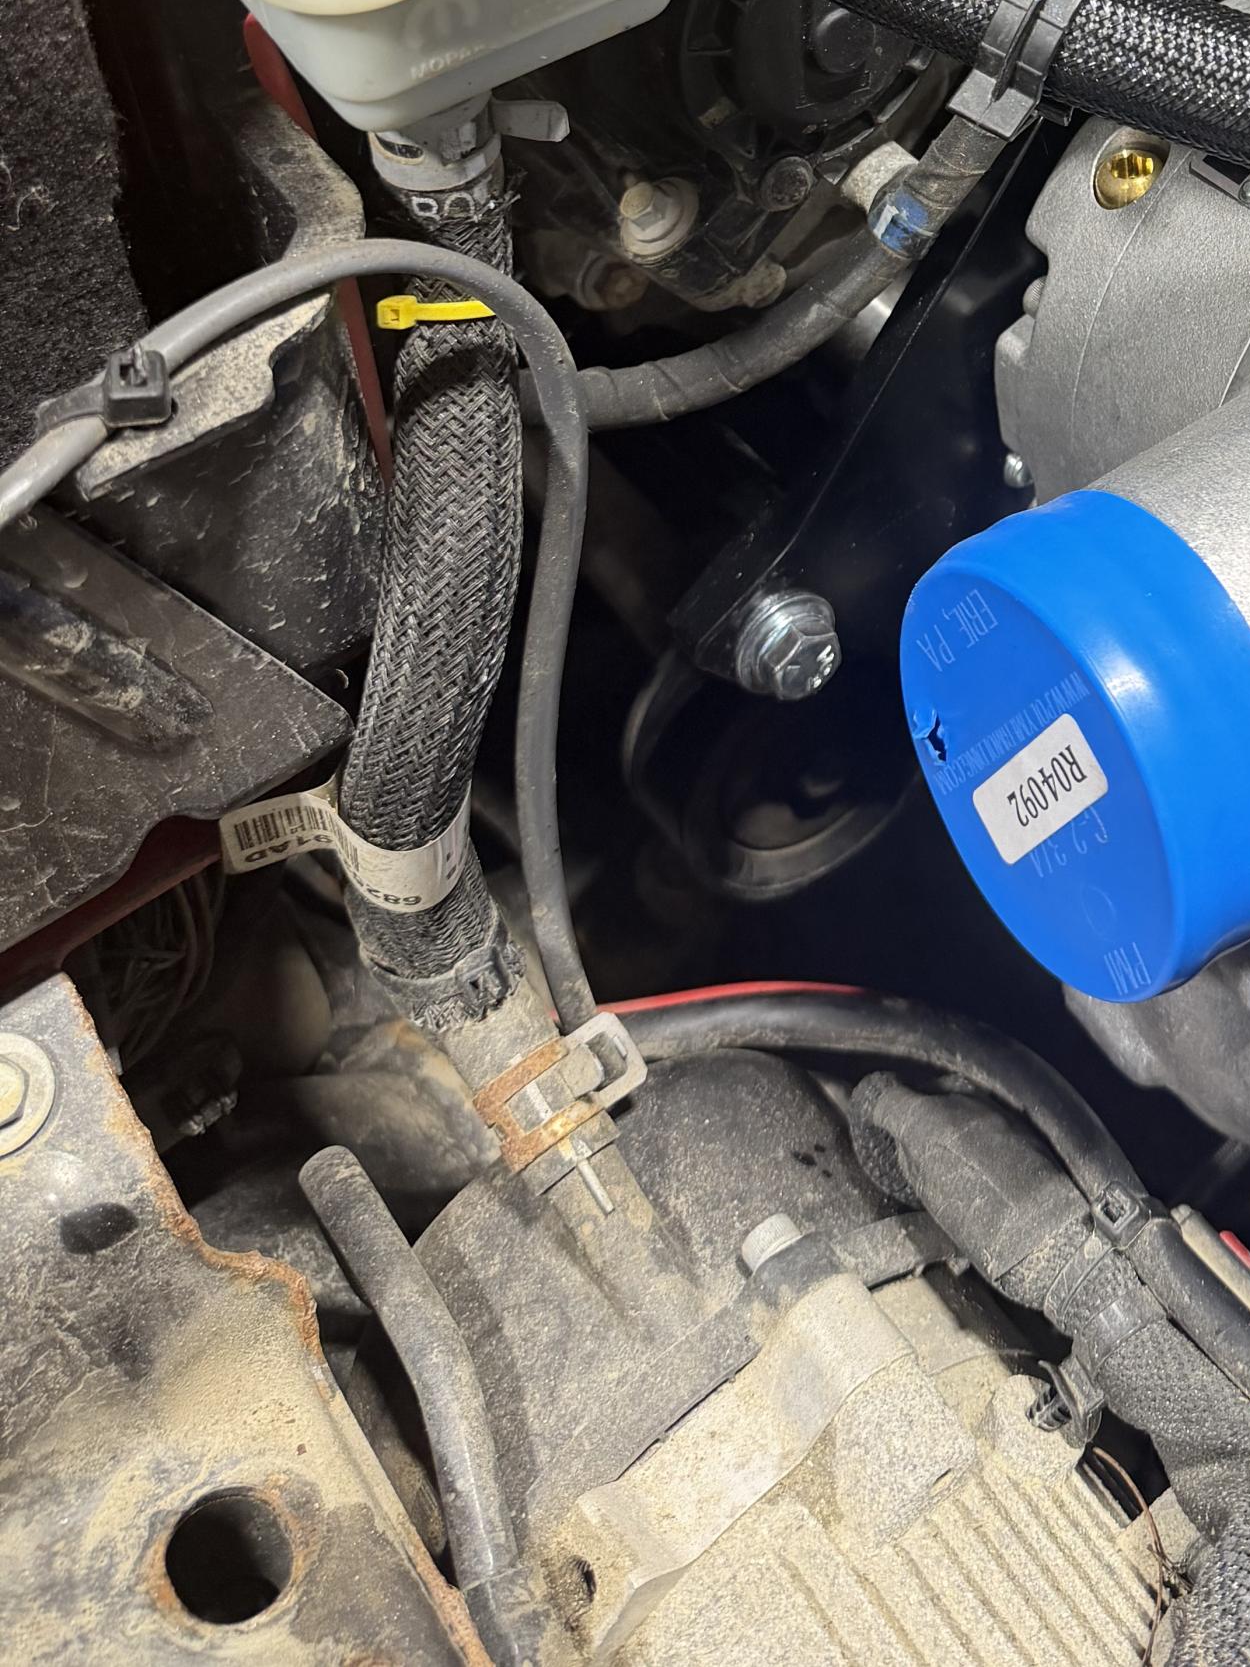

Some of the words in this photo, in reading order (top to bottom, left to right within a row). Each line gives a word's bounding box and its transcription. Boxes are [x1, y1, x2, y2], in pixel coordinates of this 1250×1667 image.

[916, 632, 957, 673] PA
[1007, 744, 1088, 828] R04092
[1103, 942, 1153, 996] PMI
